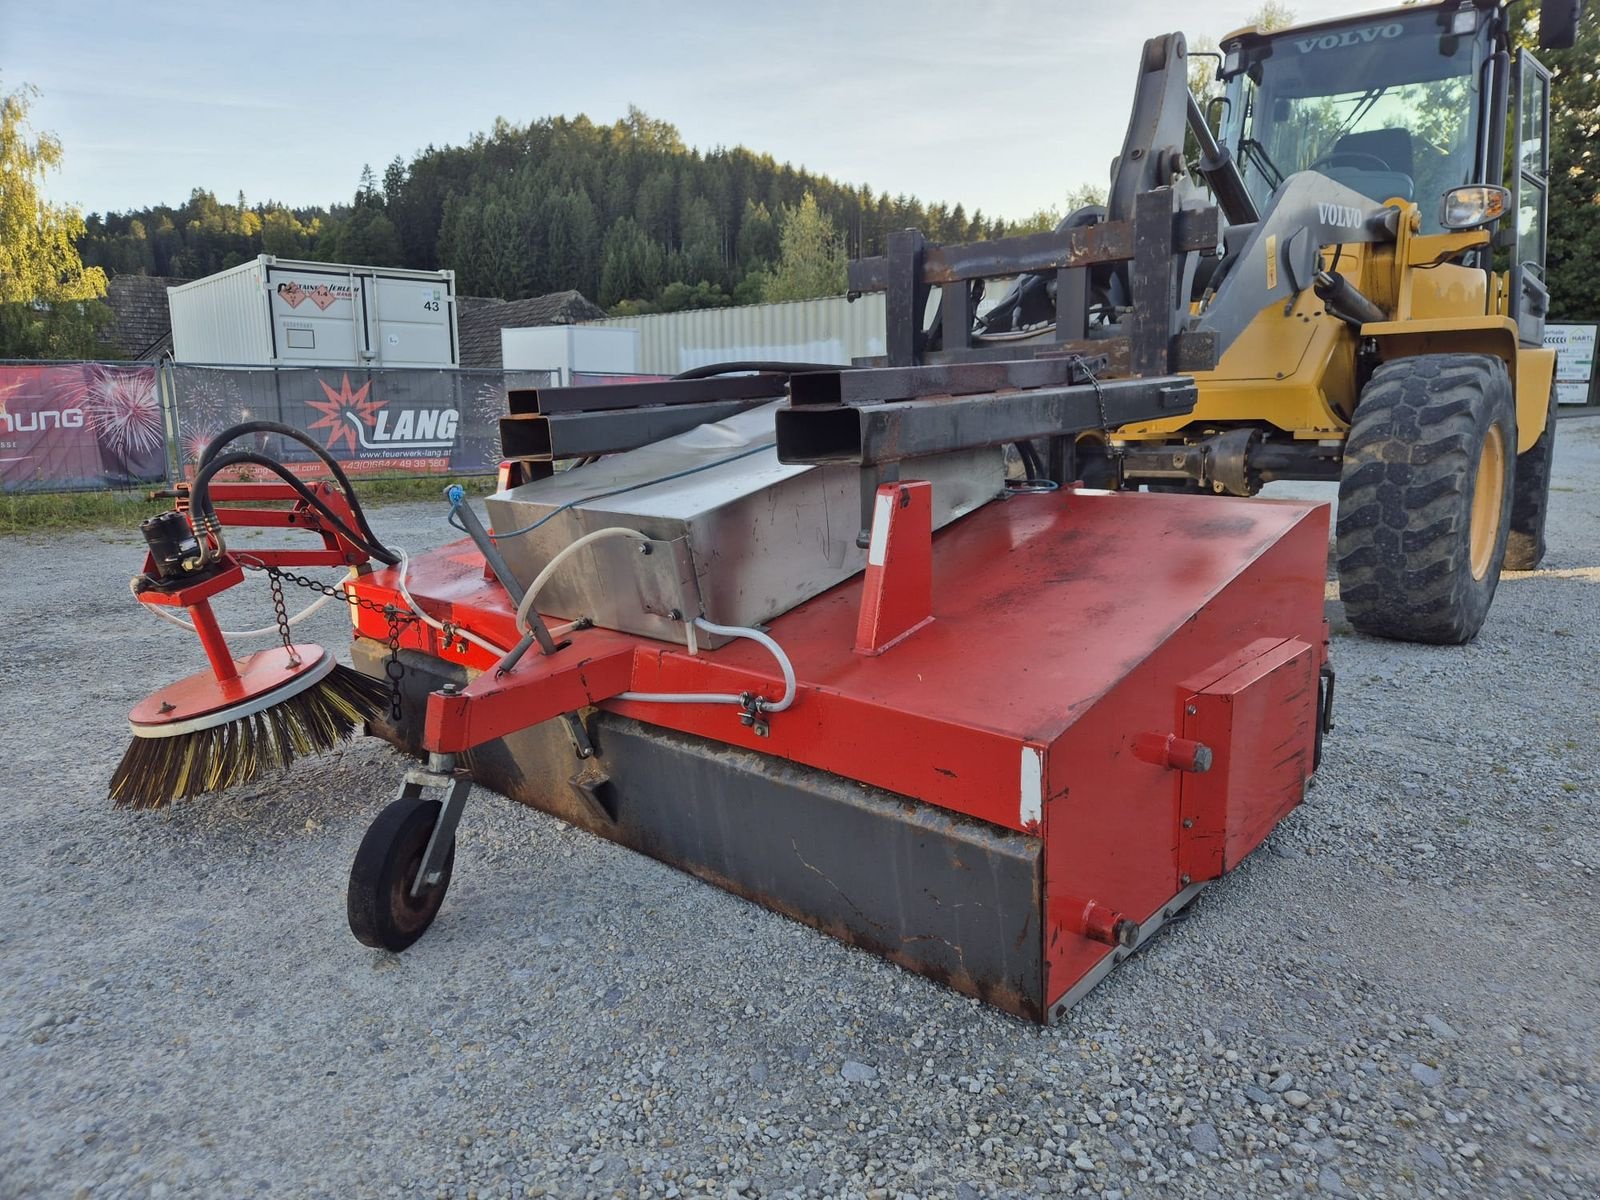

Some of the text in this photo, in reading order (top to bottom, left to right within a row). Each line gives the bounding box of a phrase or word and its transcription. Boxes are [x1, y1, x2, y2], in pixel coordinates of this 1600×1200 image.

[1295, 24, 1403, 53] VOLVO
[1317, 202, 1362, 229] VOLVO
[424, 301, 440, 312] 43
[373, 409, 460, 441] LANG
[359, 449, 452, 459] www.feuerwerk-lang.at
[414, 460, 426, 468] 39
